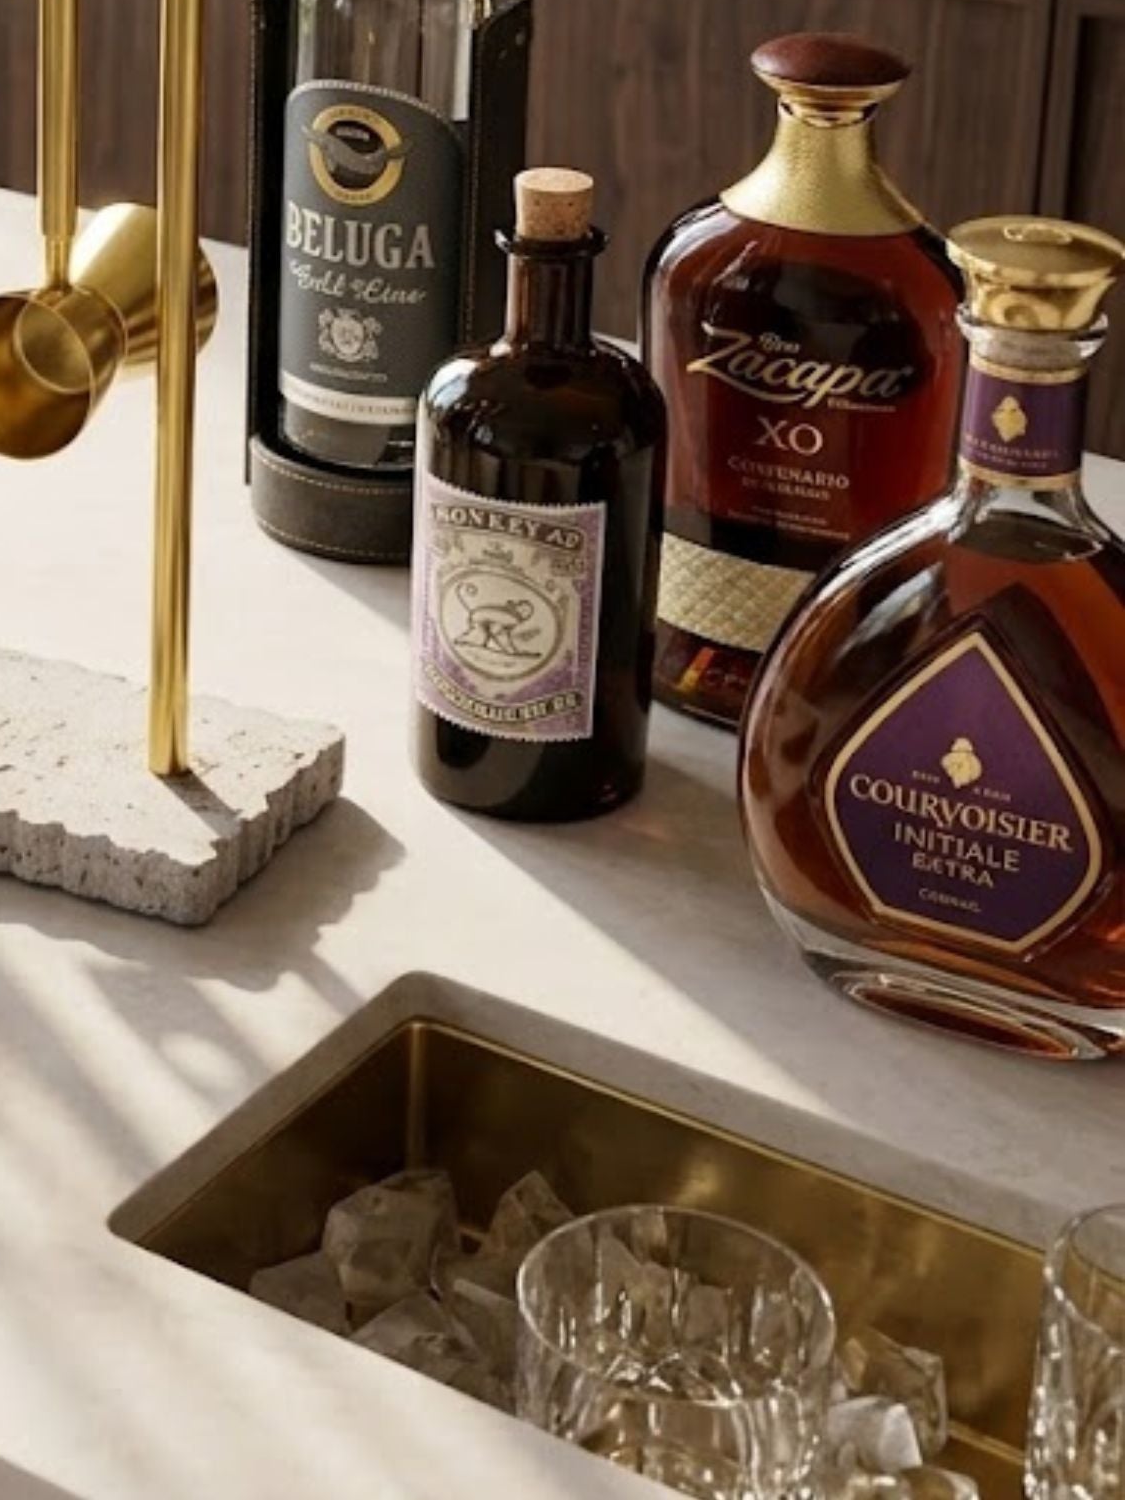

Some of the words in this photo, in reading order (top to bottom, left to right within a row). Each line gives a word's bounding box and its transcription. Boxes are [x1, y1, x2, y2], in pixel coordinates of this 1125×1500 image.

[286, 201, 435, 269] BELUGA
[686, 321, 913, 409] Zacapa
[753, 415, 823, 456] XO
[849, 773, 1073, 853] COURVOISIER
[894, 821, 1020, 872] INITIALE
